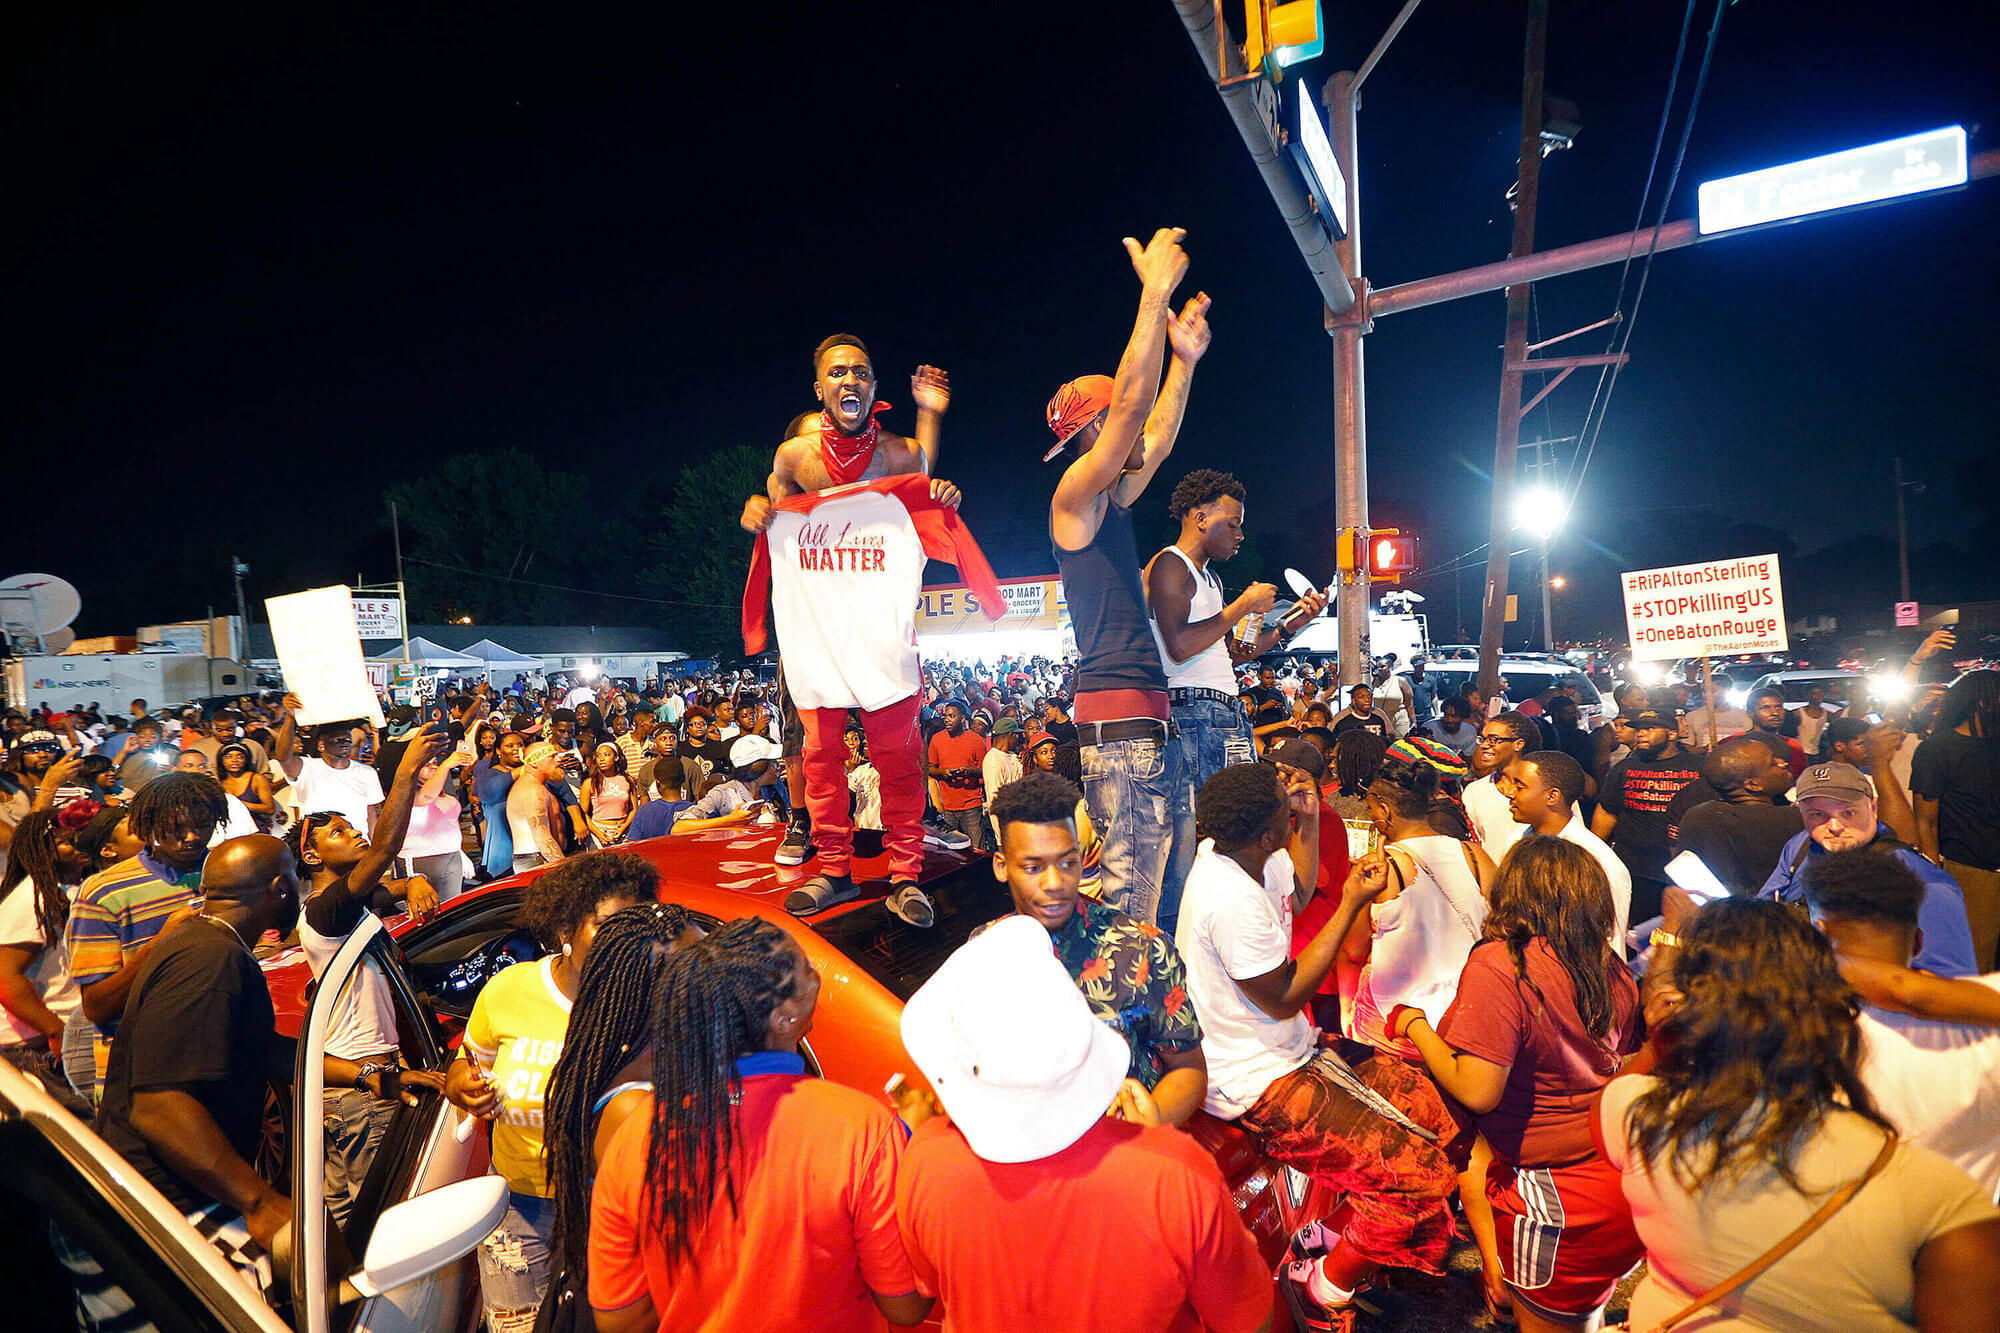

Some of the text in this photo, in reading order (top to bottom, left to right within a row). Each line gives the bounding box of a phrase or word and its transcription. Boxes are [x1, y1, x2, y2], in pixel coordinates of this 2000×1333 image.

[1759, 168, 1865, 208] Foster
[797, 521, 888, 549] All Lives
[799, 548, 886, 573] MATTER
[1628, 560, 1771, 592] #RiPAltonSterling
[963, 590, 982, 614] S
[1012, 599, 1041, 607] GROCERY
[1016, 586, 1041, 598] MART
[1632, 587, 1774, 621] #STOPkillingUS
[1635, 617, 1777, 645] #OneBatonRouge
[1704, 638, 1780, 653] @TheAaronMoses
[58, 679, 113, 688] NBC NEWS
[1179, 688, 1230, 704] EPLICIT
